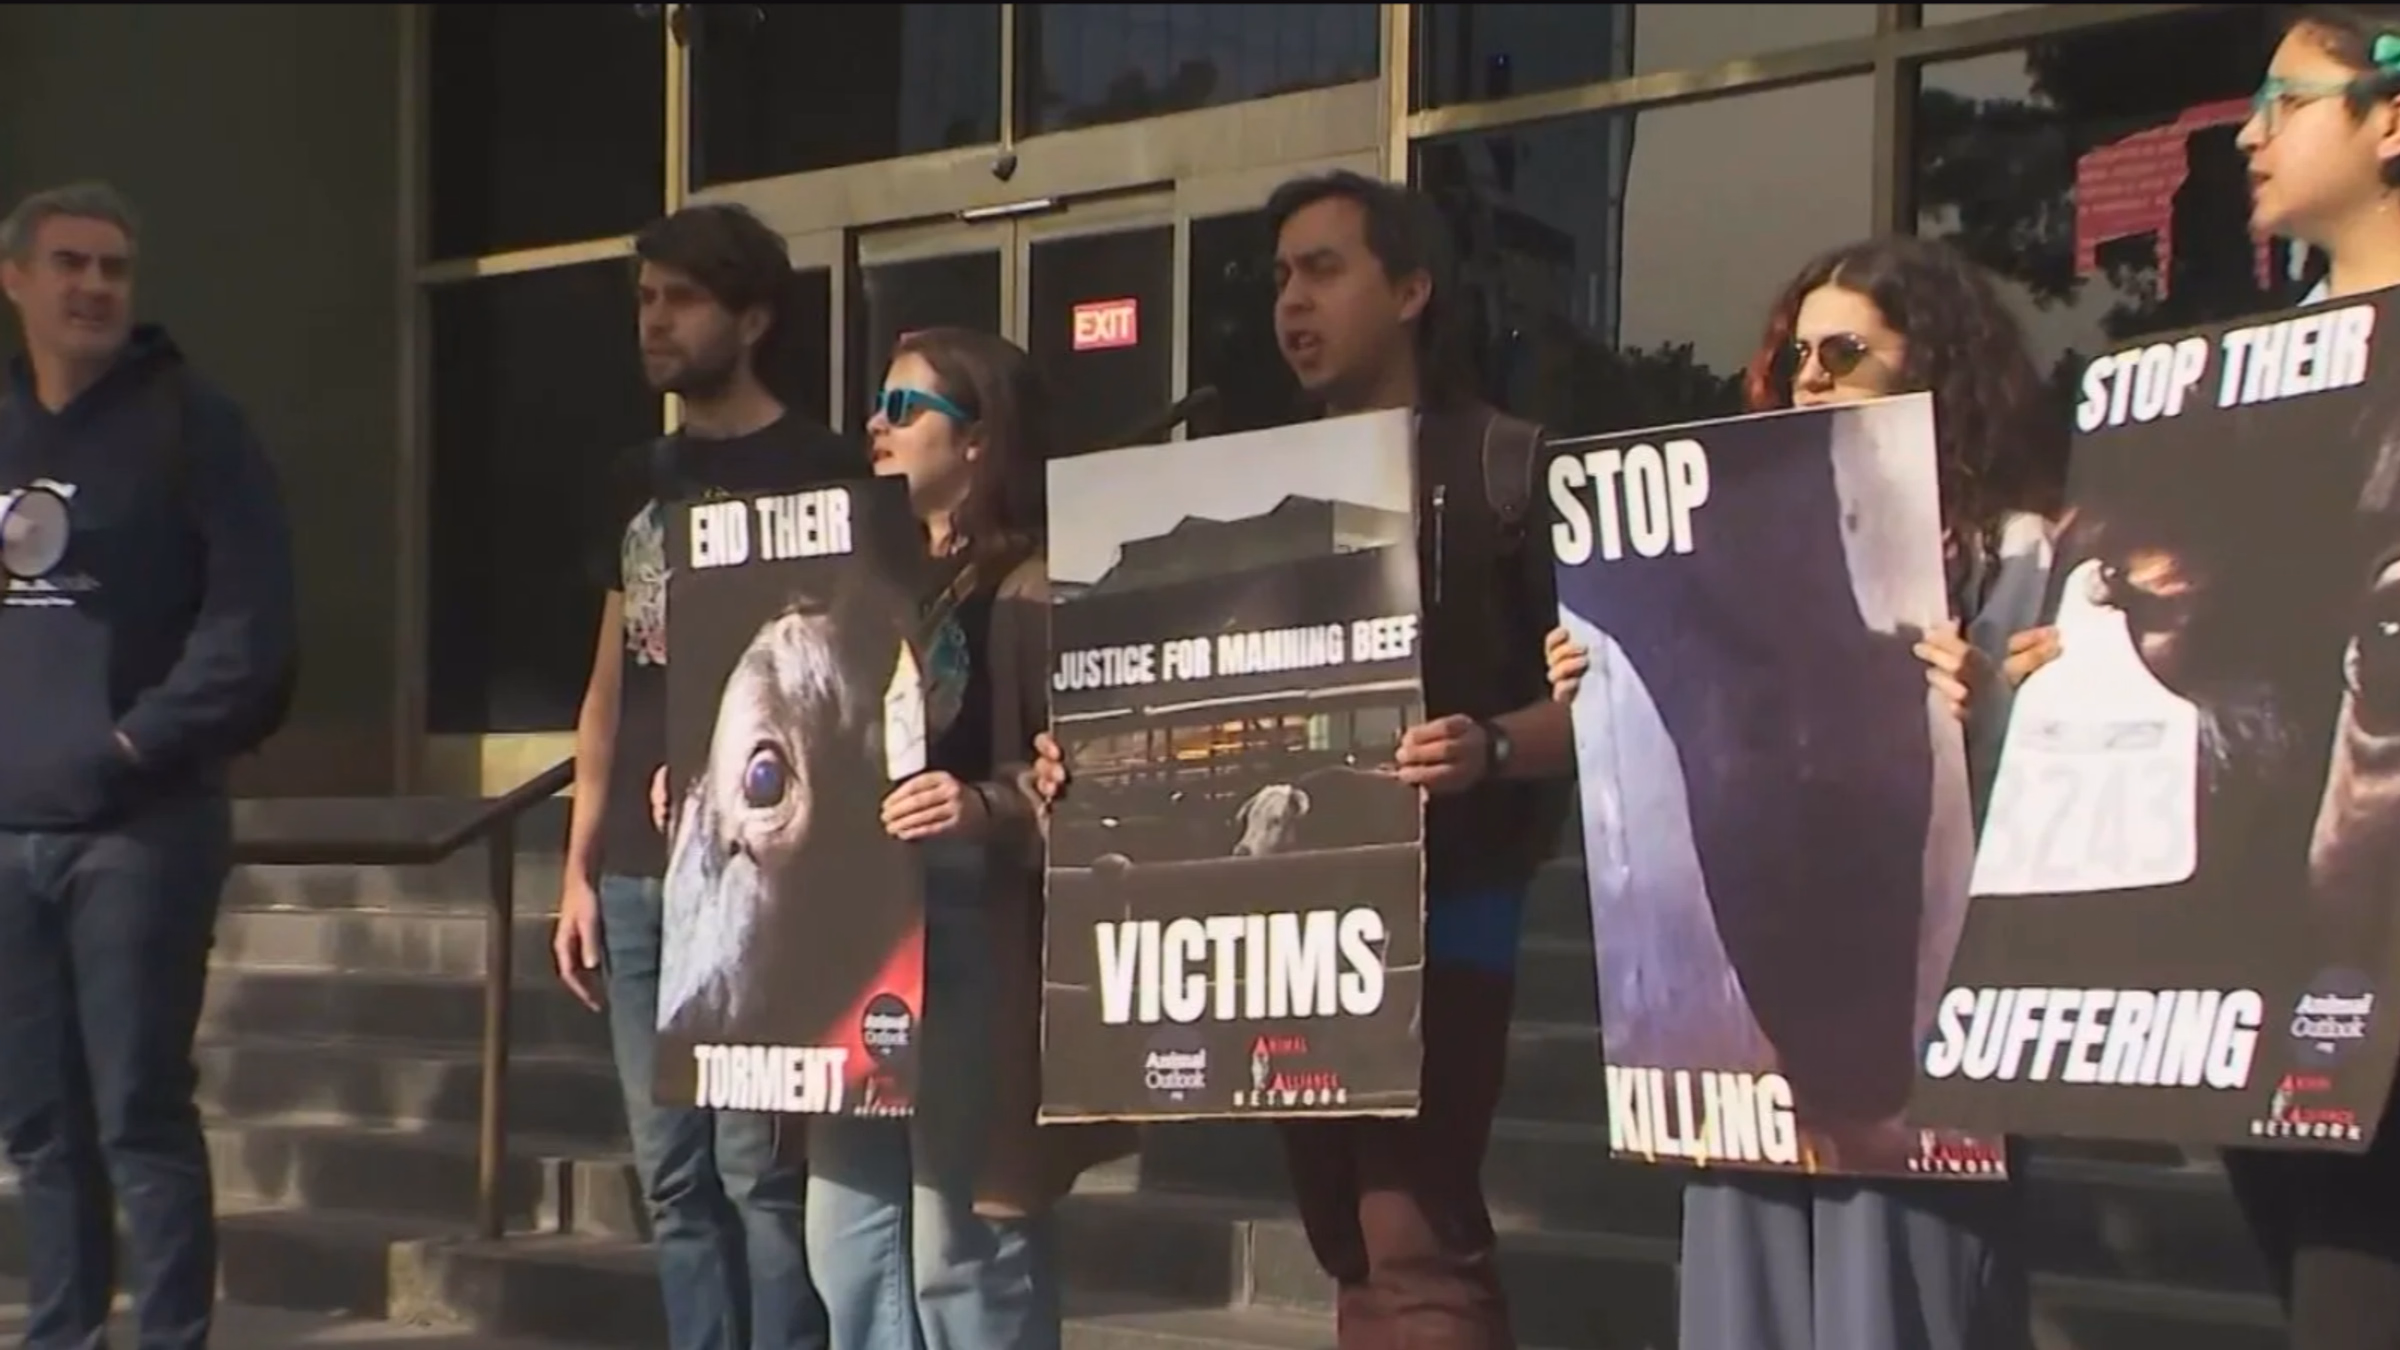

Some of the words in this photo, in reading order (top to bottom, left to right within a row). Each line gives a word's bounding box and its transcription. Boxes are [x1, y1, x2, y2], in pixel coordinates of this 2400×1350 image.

[1075, 307, 1134, 342] EXIT
[2077, 337, 2208, 432] STOP
[2217, 305, 2376, 408] THEIR
[690, 501, 748, 569] END
[755, 488, 853, 561] THEIR
[1548, 439, 1710, 566] STOP
[1053, 643, 1155, 692] JUSTICE
[1162, 637, 1211, 681] FOR
[1217, 623, 1345, 676] MANNING
[1351, 614, 1418, 663] BEEF
[1095, 907, 1386, 1025] VICTIMS
[694, 1044, 848, 1113] TORMENT
[1924, 987, 2263, 1089] SUFFERING
[1605, 1065, 1798, 1164] KILLING
